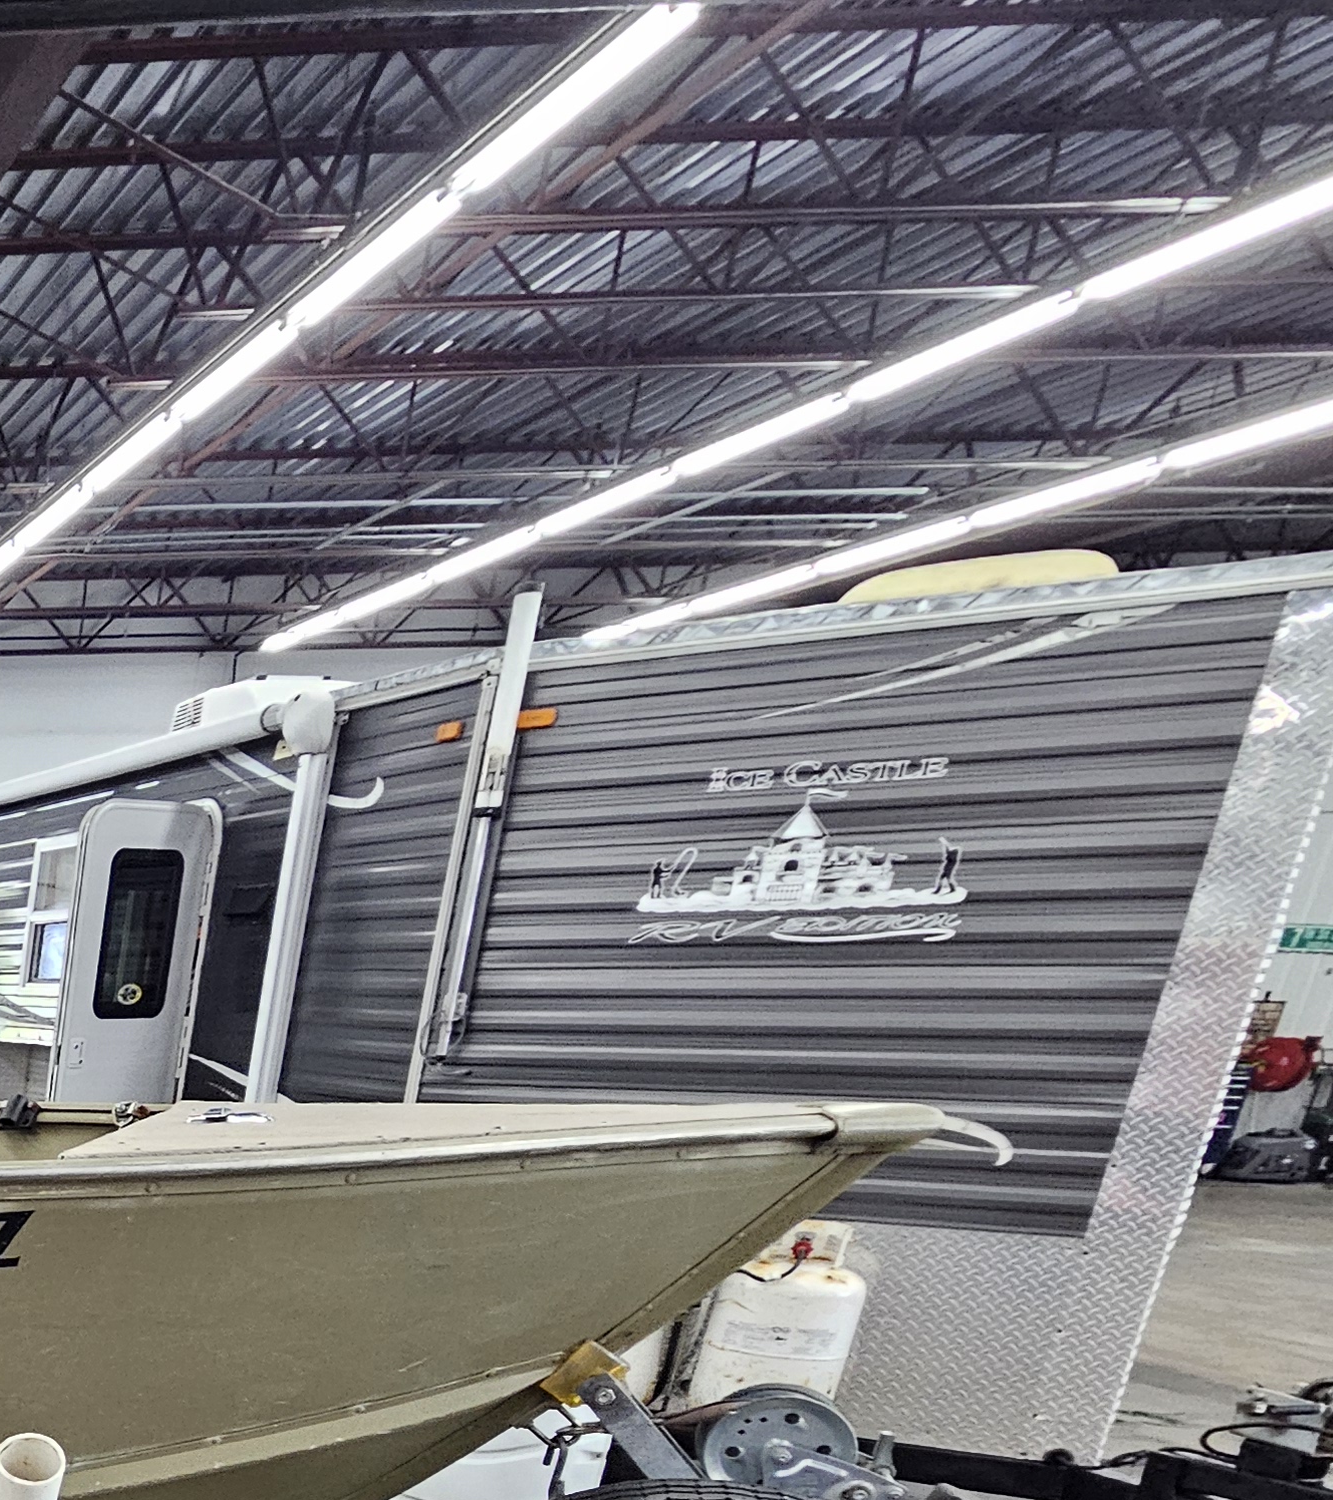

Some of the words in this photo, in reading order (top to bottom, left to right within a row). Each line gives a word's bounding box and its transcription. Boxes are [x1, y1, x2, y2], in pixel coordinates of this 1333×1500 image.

[706, 767, 774, 792] ICE
[783, 757, 950, 787] CASTLE
[628, 915, 781, 943] RV
